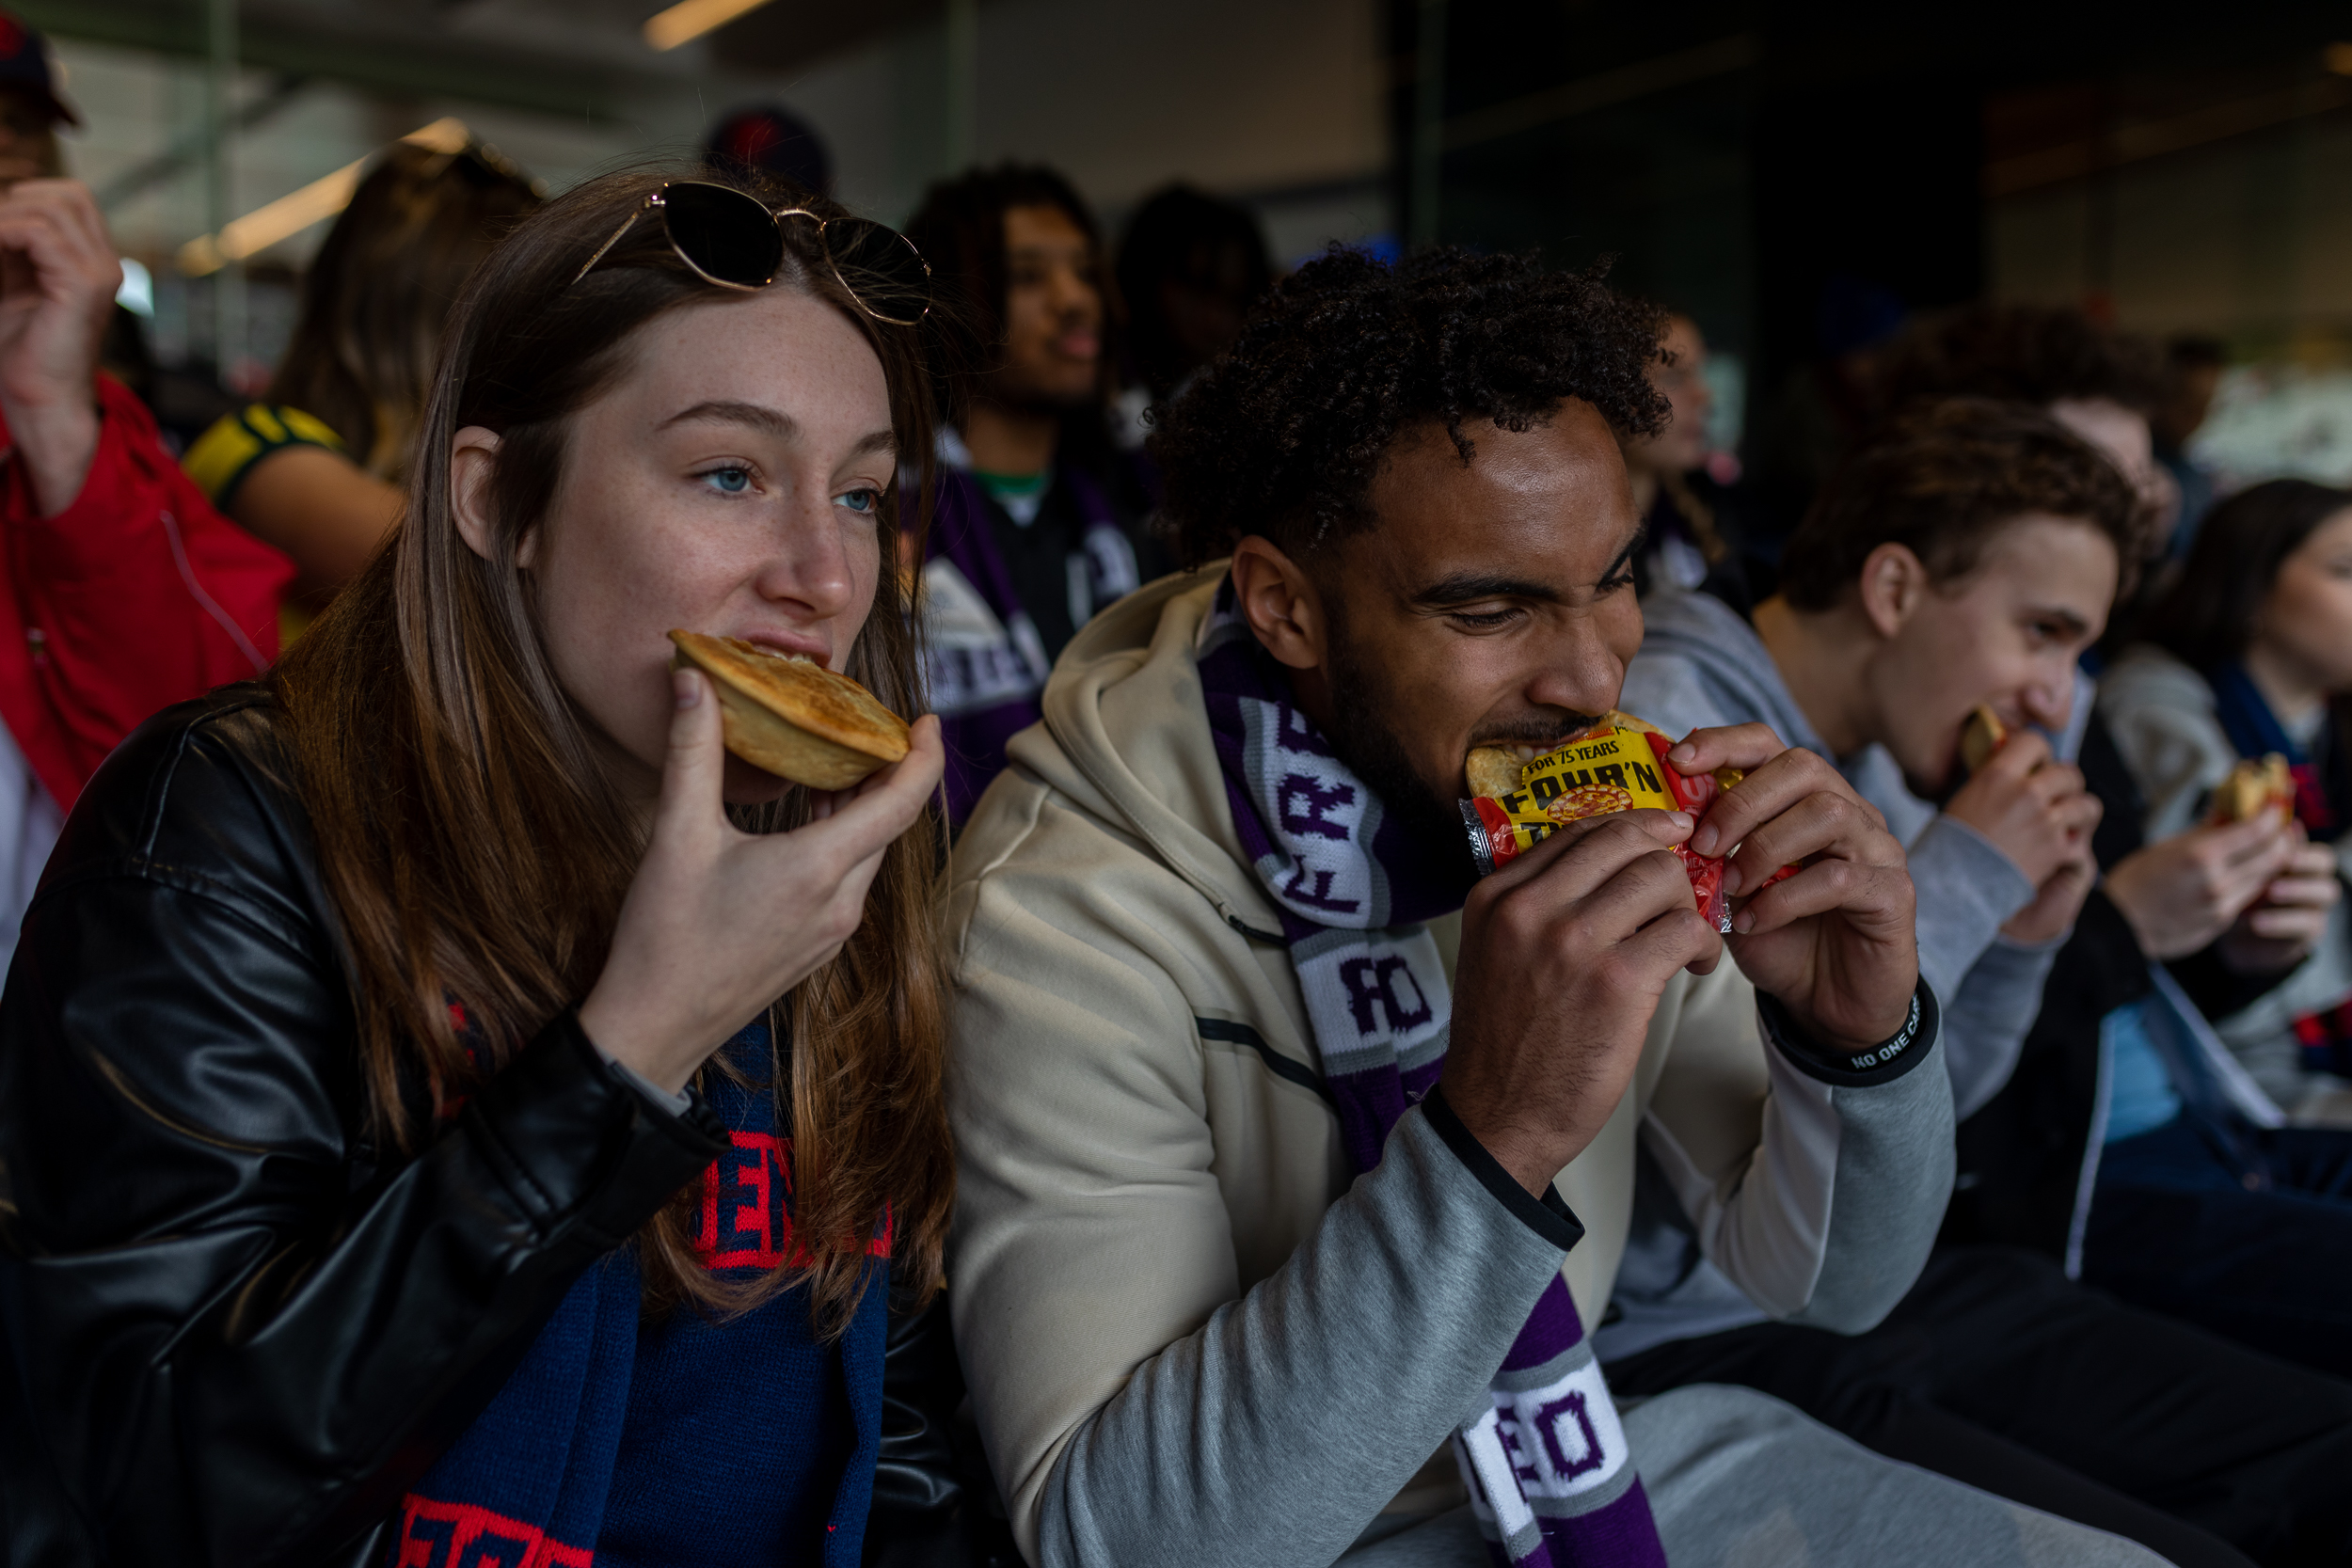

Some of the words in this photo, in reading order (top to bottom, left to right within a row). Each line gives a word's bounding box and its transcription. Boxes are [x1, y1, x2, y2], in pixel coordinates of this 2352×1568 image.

[1526, 756, 1556, 774] FOR
[1556, 749, 1575, 765] 75
[1575, 741, 1619, 760] YEARS
[1683, 857, 1708, 869] MEA
[1851, 1053, 1878, 1069] NO
[1878, 1032, 1910, 1061] ONE
